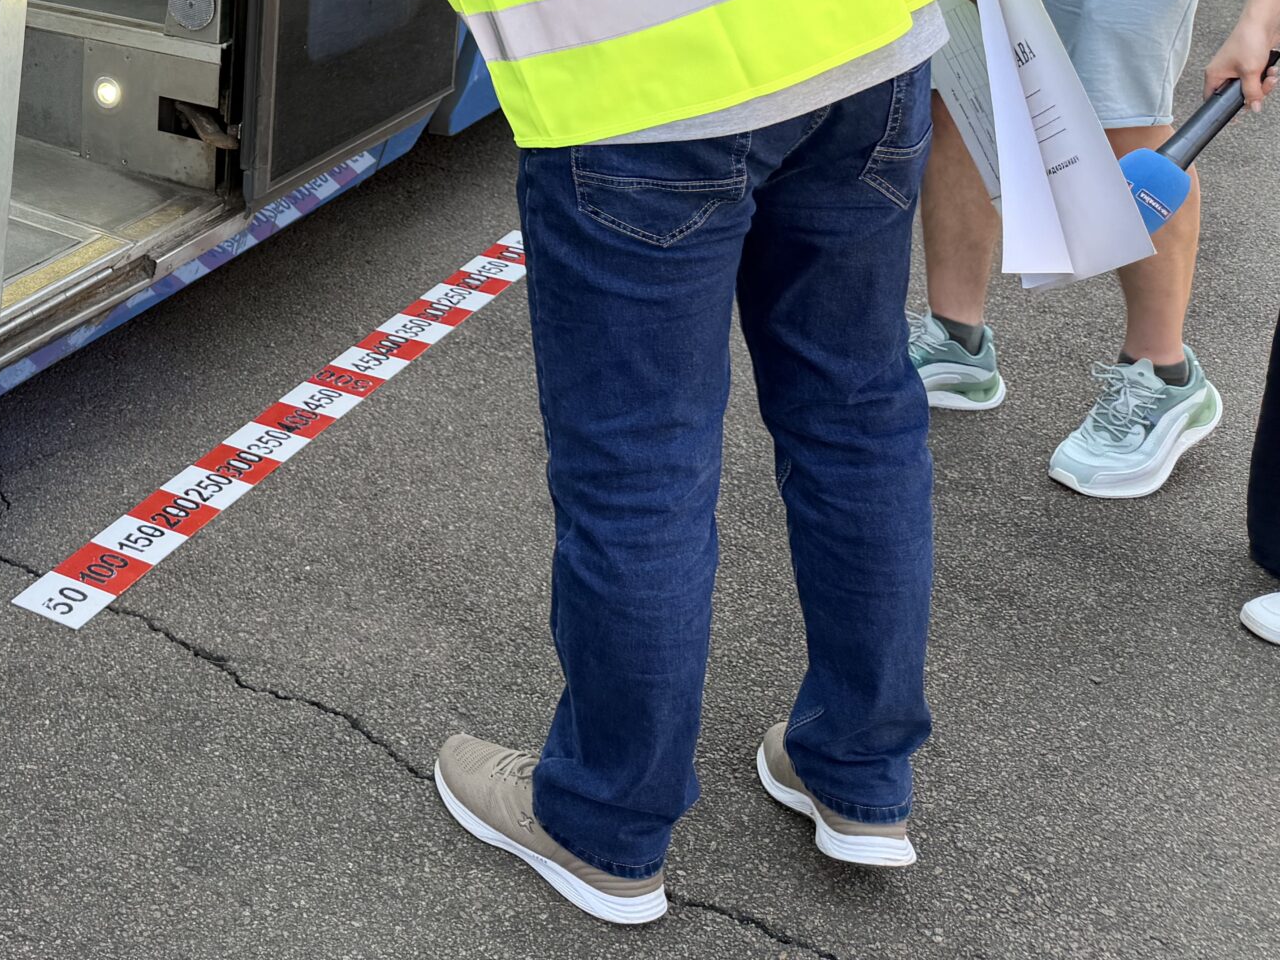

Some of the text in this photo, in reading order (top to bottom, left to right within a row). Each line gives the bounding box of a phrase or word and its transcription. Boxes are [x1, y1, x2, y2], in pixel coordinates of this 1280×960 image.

[42, 587, 88, 615] 50
[79, 554, 129, 583] 100
[117, 524, 166, 552] 150
[151, 496, 202, 529] 200
[184, 473, 233, 503] 250
[216, 450, 264, 479] 300
[247, 429, 292, 455] 350
[277, 408, 319, 432] 400
[304, 389, 343, 411] 450
[395, 318, 432, 338] 350
[437, 287, 473, 306] 250
